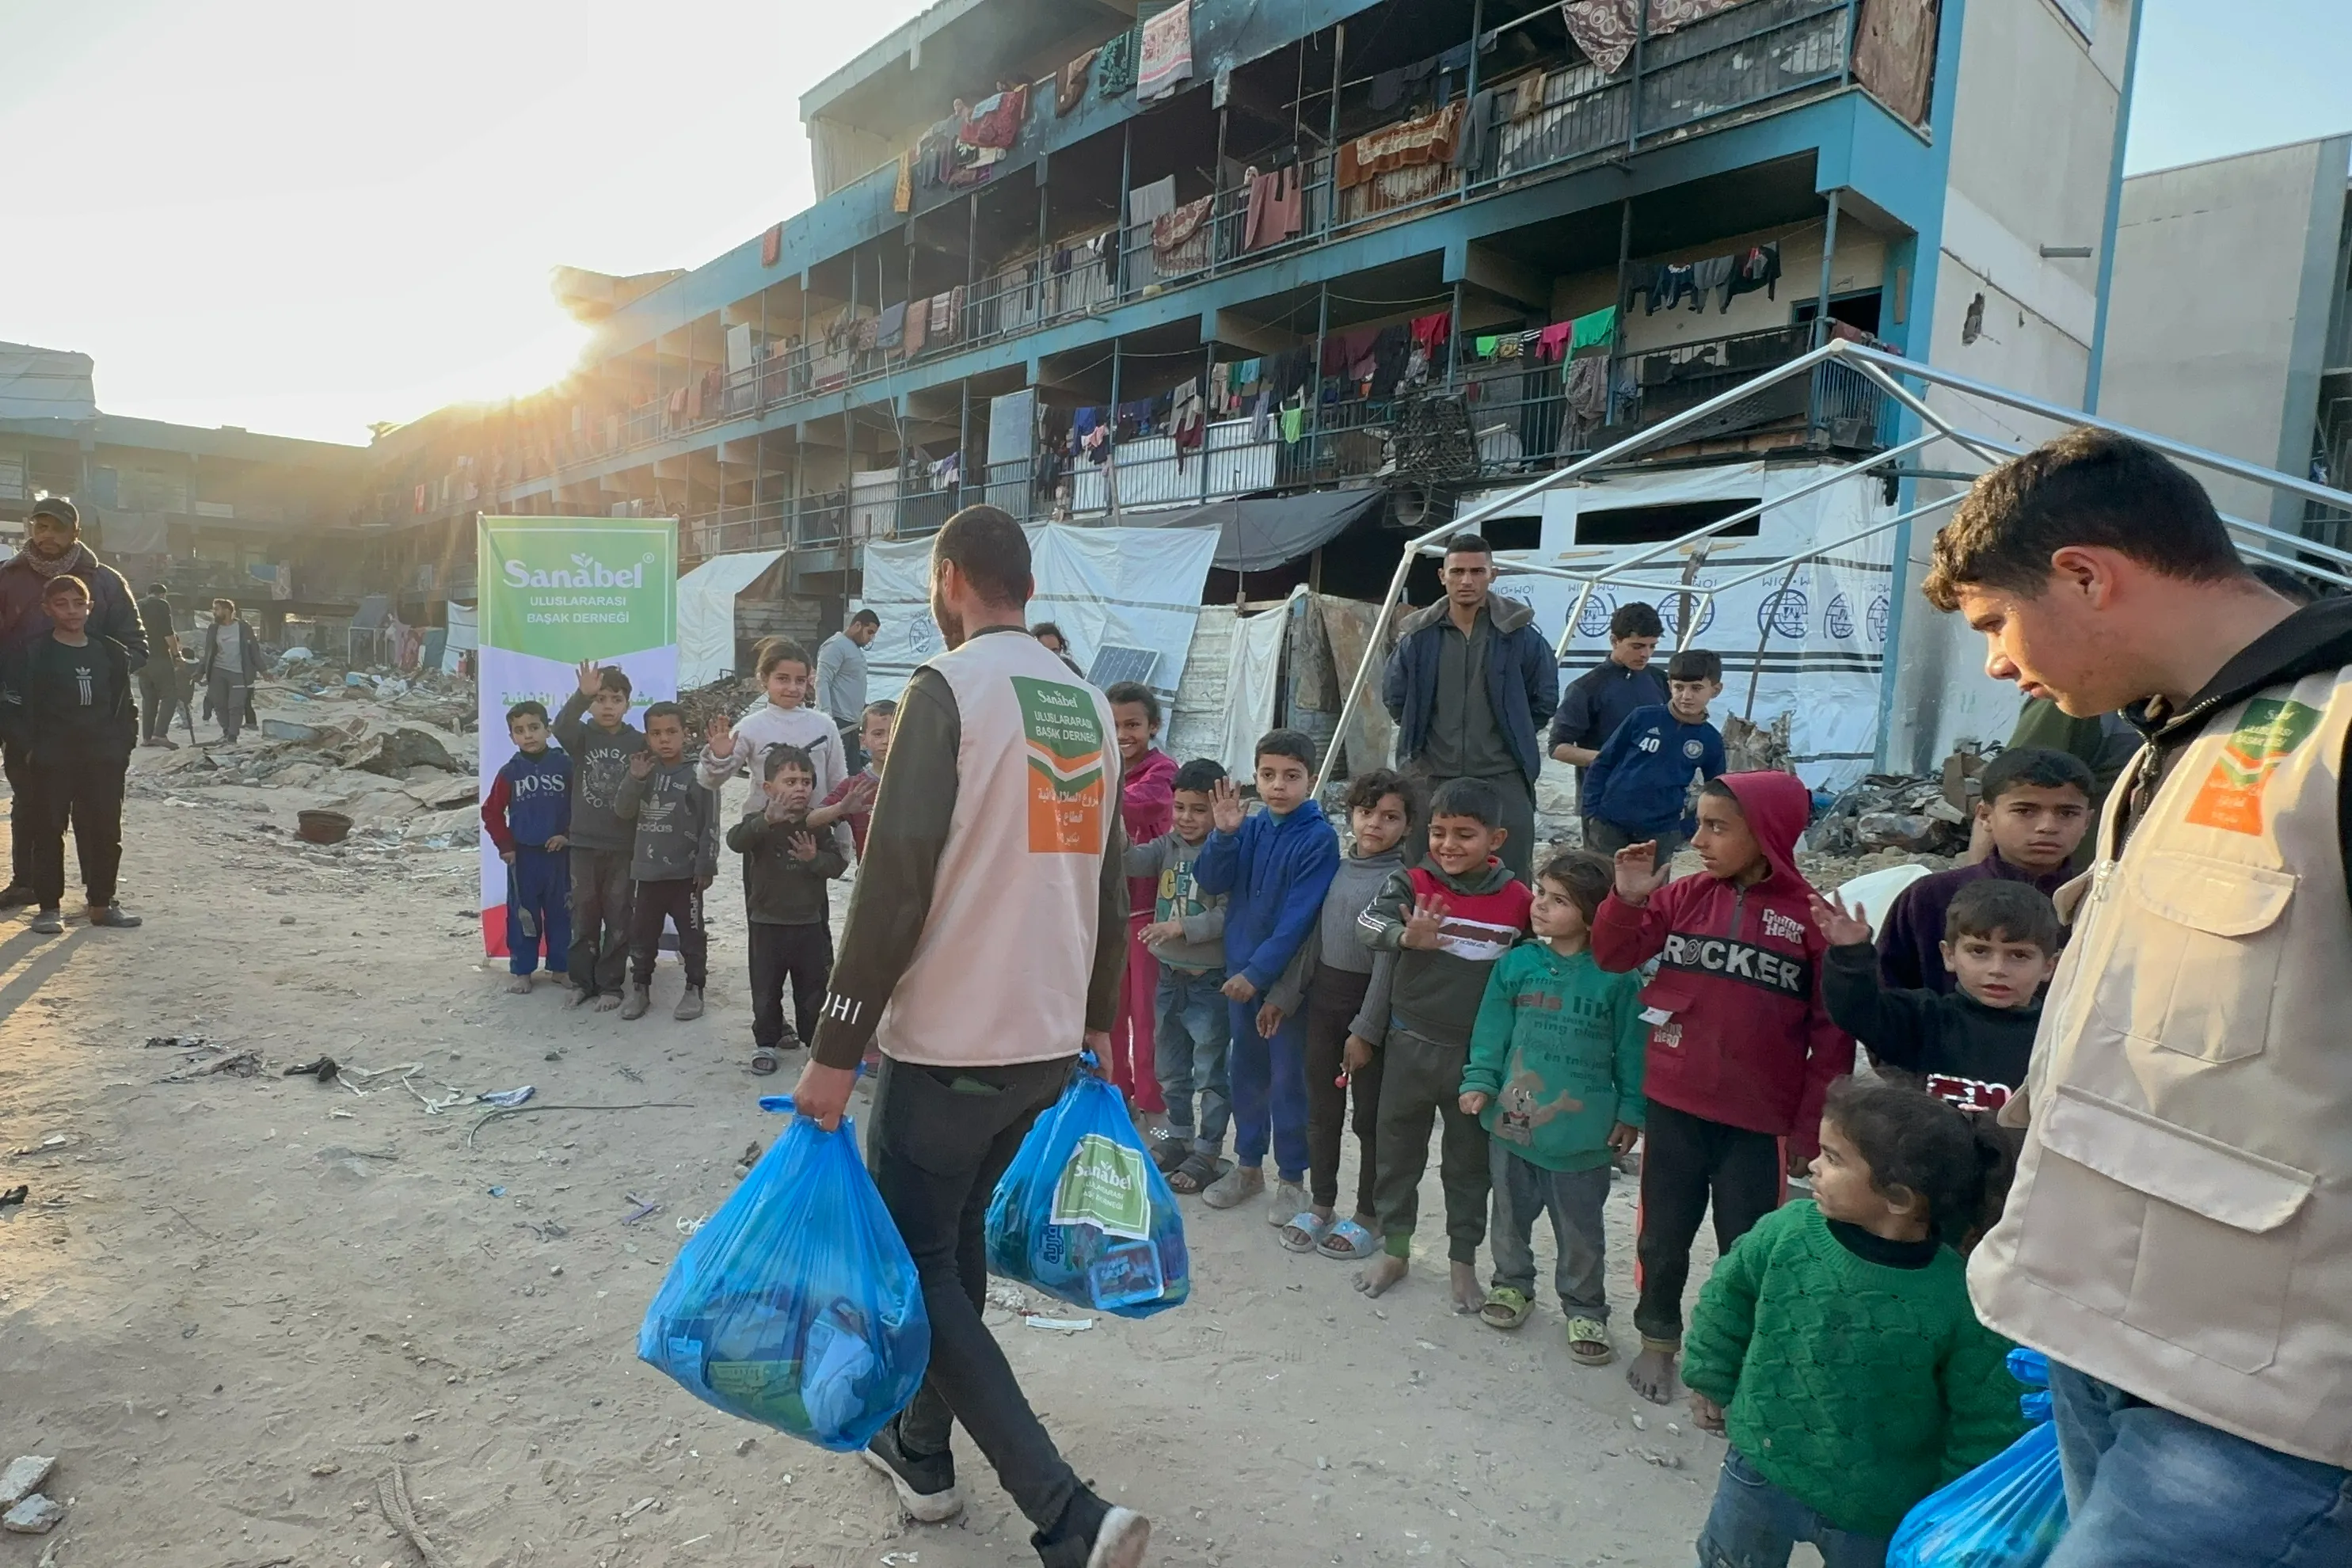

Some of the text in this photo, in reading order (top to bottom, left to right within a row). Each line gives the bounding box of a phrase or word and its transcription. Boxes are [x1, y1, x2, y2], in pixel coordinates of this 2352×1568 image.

[503, 558, 642, 588] Sanabel
[530, 596, 626, 607] ULUSLARARASI
[527, 611, 630, 625] BAŞAK DERNEĞİ
[1037, 690, 1078, 708] Sanabel
[1033, 710, 1094, 729] ULUSLARARASI
[1035, 725, 1061, 740] BAŞAK
[1638, 736, 1661, 753] 40
[584, 748, 629, 768] JUNGL
[515, 774, 565, 797] BOSS
[1662, 934, 1802, 991] ROCKER
